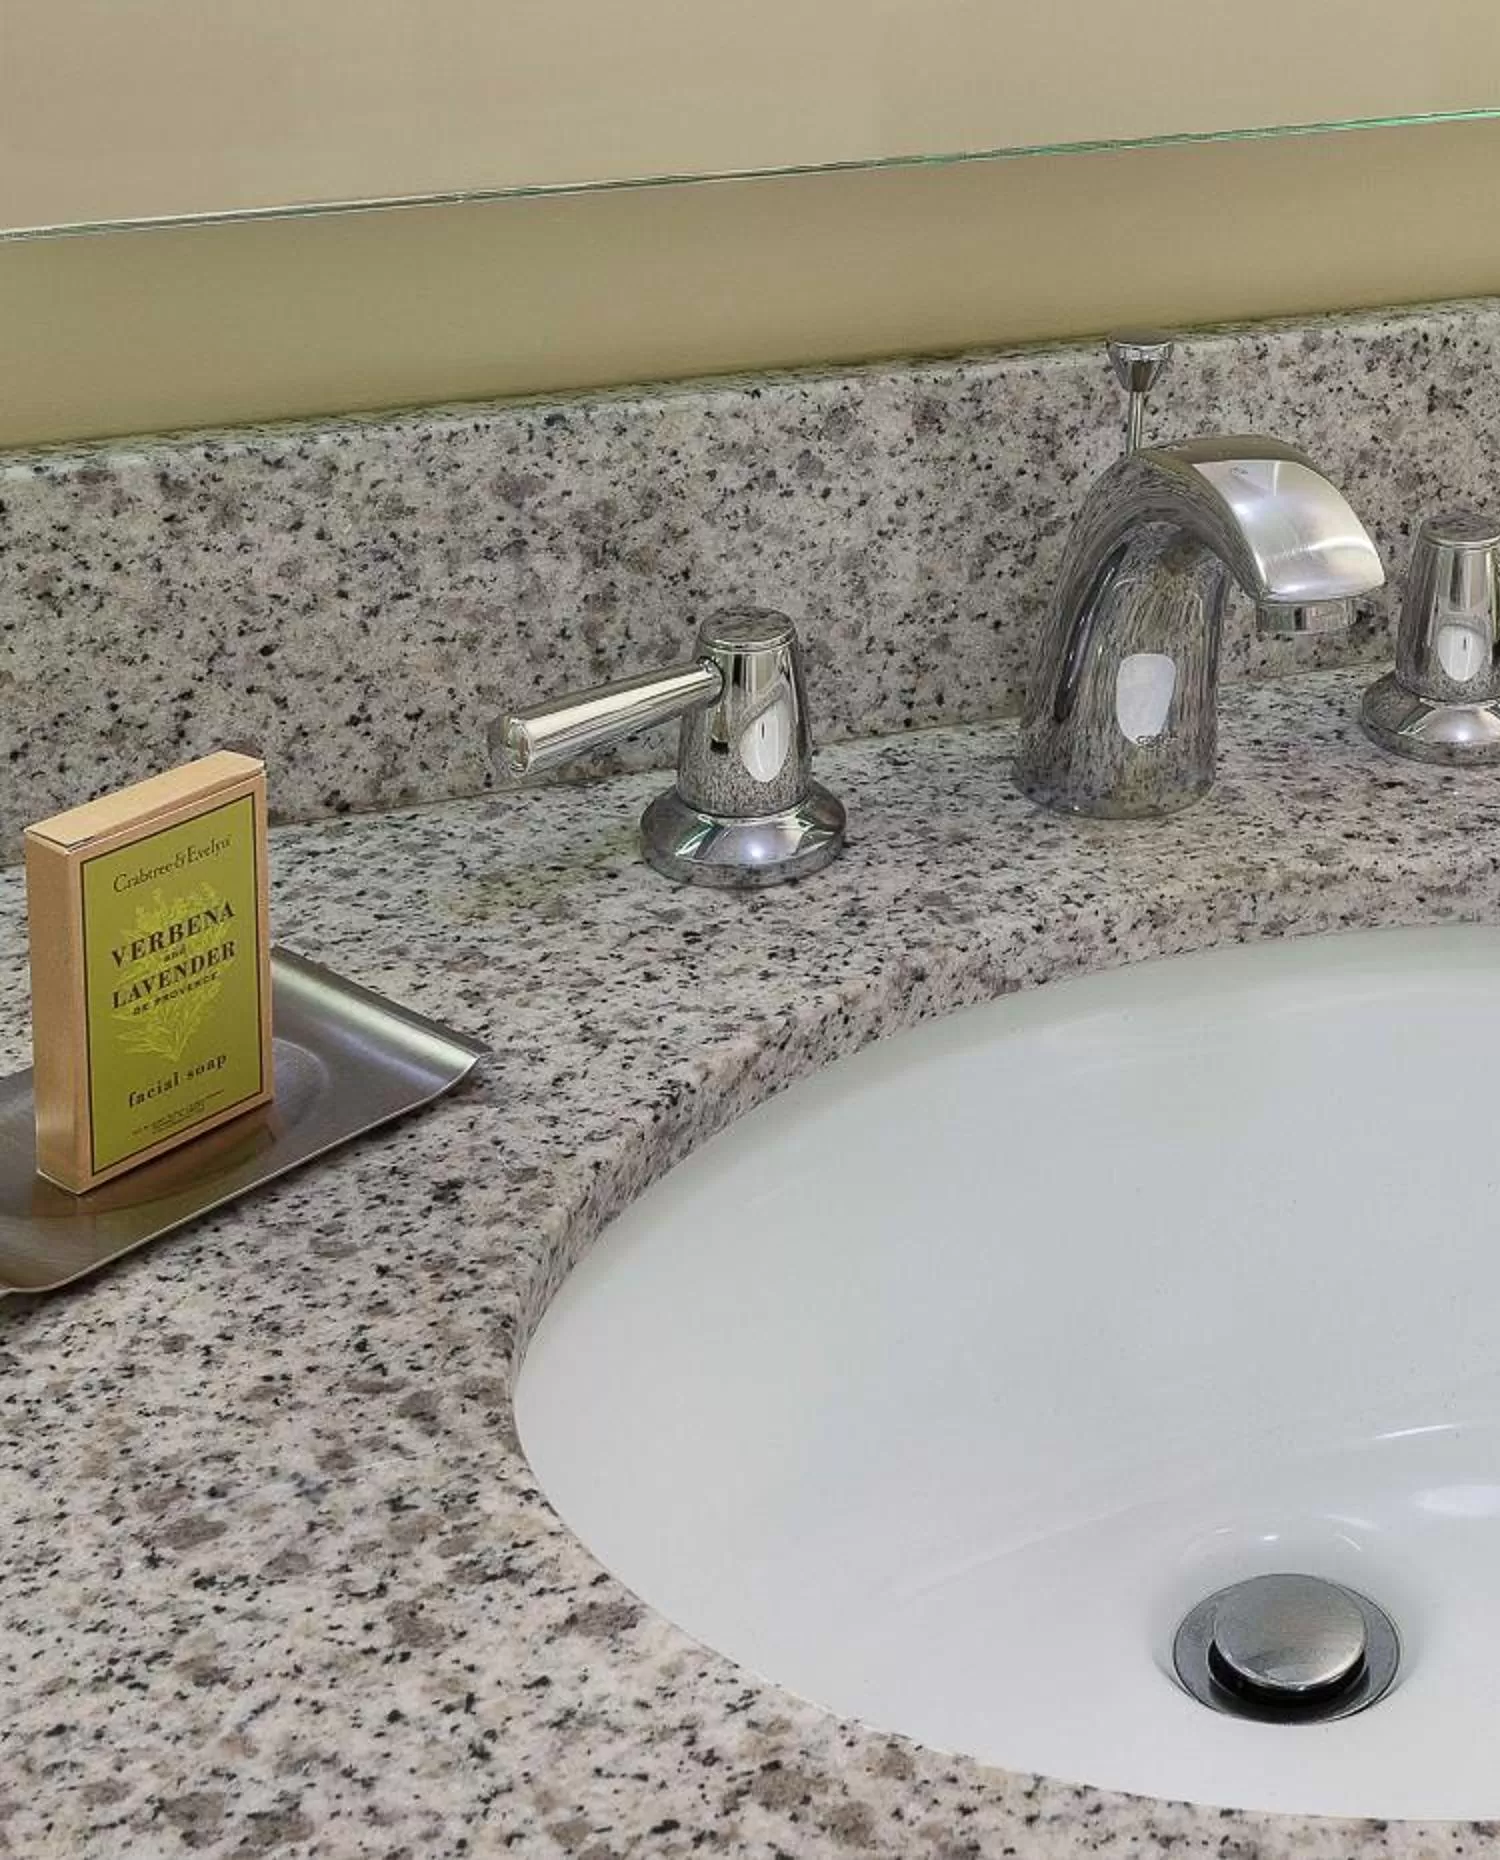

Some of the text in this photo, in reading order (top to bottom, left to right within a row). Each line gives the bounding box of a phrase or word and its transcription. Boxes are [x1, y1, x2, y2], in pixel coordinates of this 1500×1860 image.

[113, 862, 173, 893] Crabtree
[186, 836, 231, 863] Evelyn
[111, 901, 236, 968] VERBENA
[112, 941, 236, 1009] LAVENDER
[128, 1054, 227, 1109] facial soap
